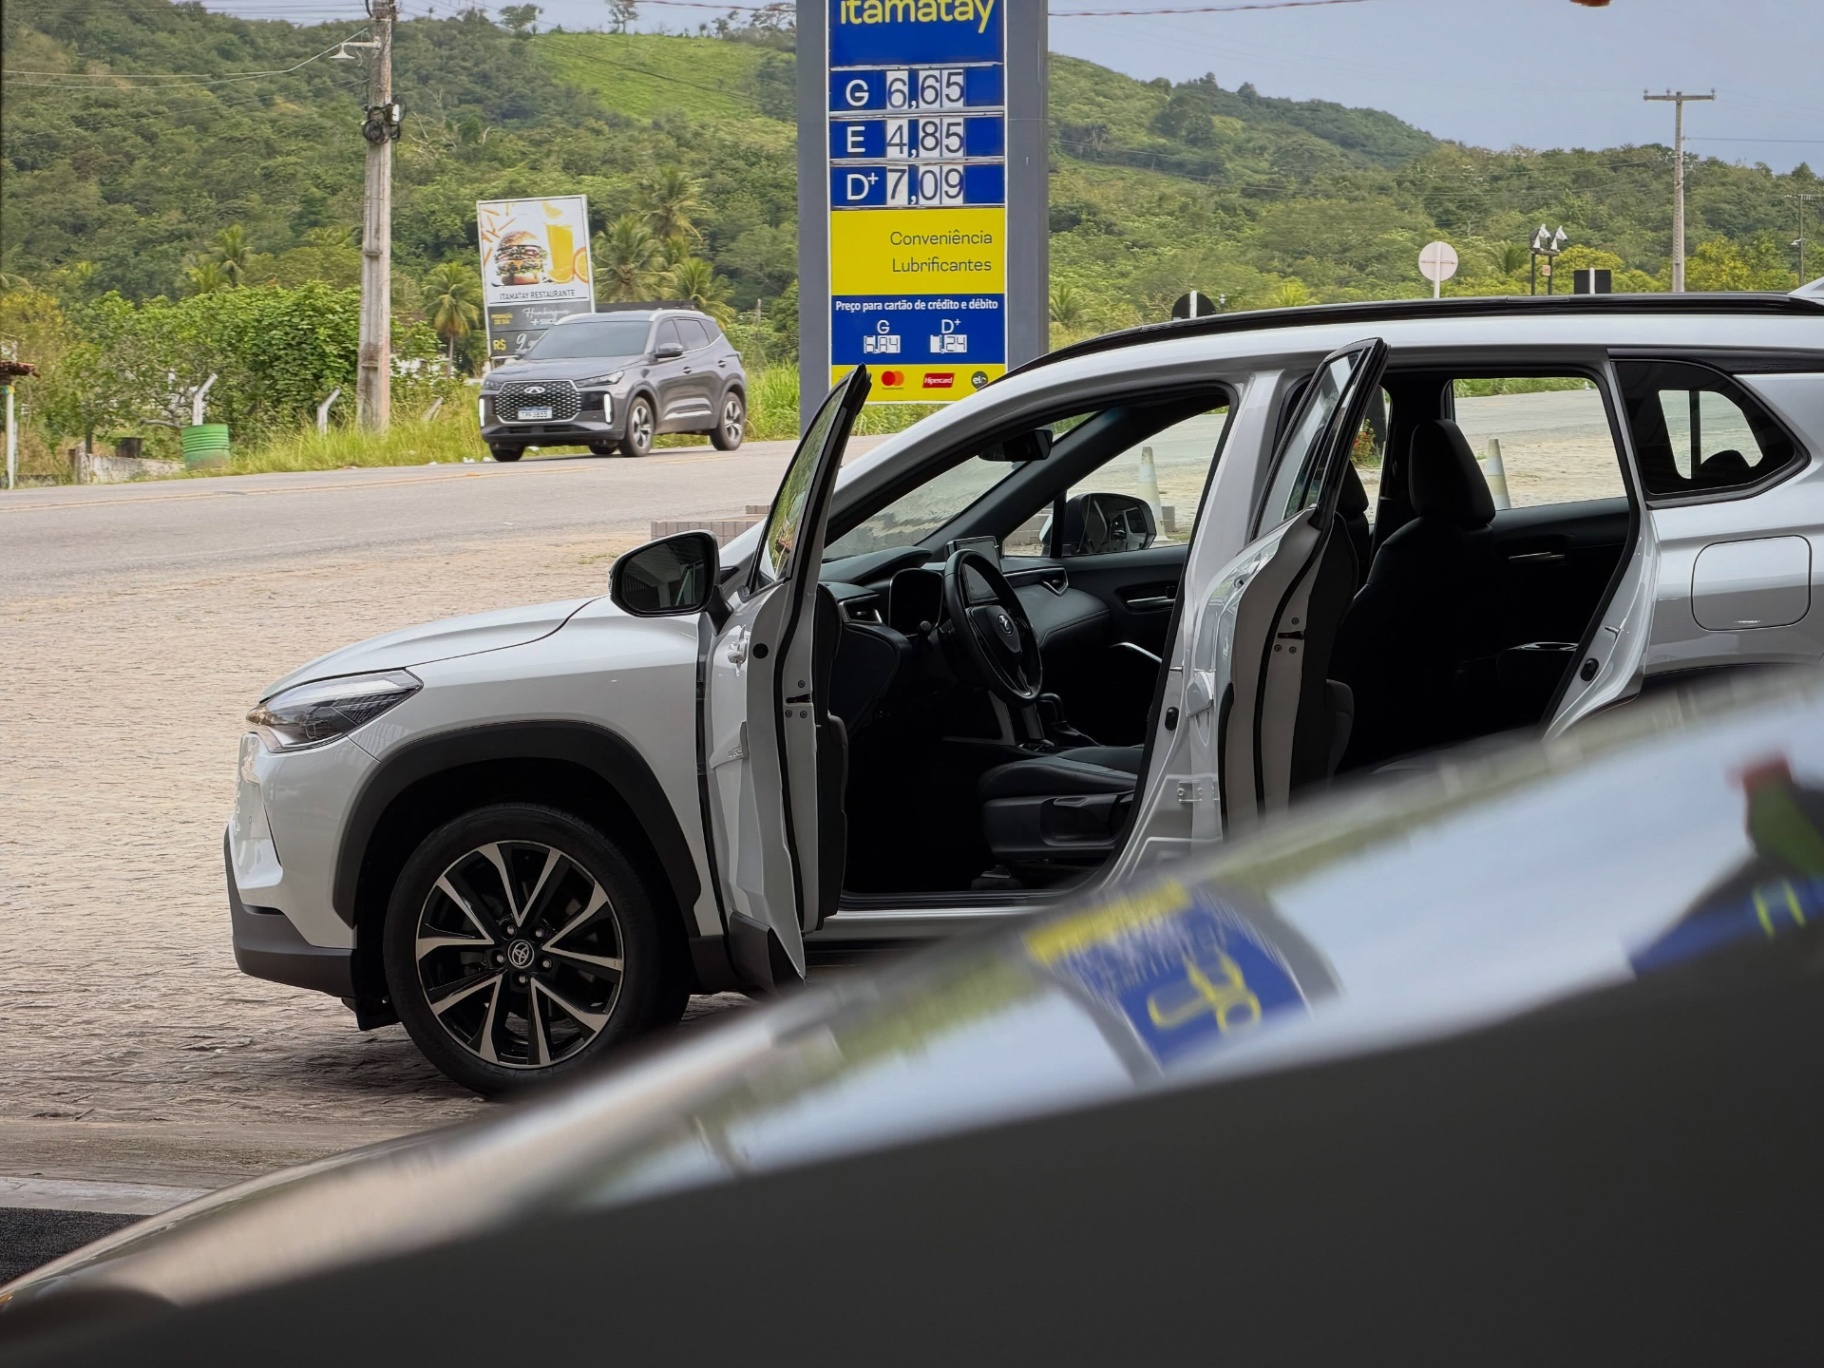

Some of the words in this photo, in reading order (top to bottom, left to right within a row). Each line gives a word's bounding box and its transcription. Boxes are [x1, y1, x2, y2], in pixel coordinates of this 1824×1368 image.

[840, 0, 994, 34] itamatay
[845, 79, 869, 107] G
[887, 72, 965, 109] 6,65
[847, 126, 866, 153] E
[887, 121, 964, 158] 4,85
[846, 173, 879, 200] D+
[887, 168, 963, 204] 7,09
[890, 229, 993, 246] Conveniência
[892, 256, 992, 273] Lubrificantes
[499, 292, 529, 300] ITAMATAY
[530, 289, 575, 299] RESTAURANTE
[835, 301, 861, 313] Preço
[862, 303, 883, 313] para
[884, 299, 912, 310] cartão
[914, 299, 925, 310] de
[927, 299, 959, 311] crédito
[968, 298, 999, 310] débito
[876, 319, 890, 334] G
[492, 339, 507, 351] R$
[924, 375, 953, 385] Hipercard
